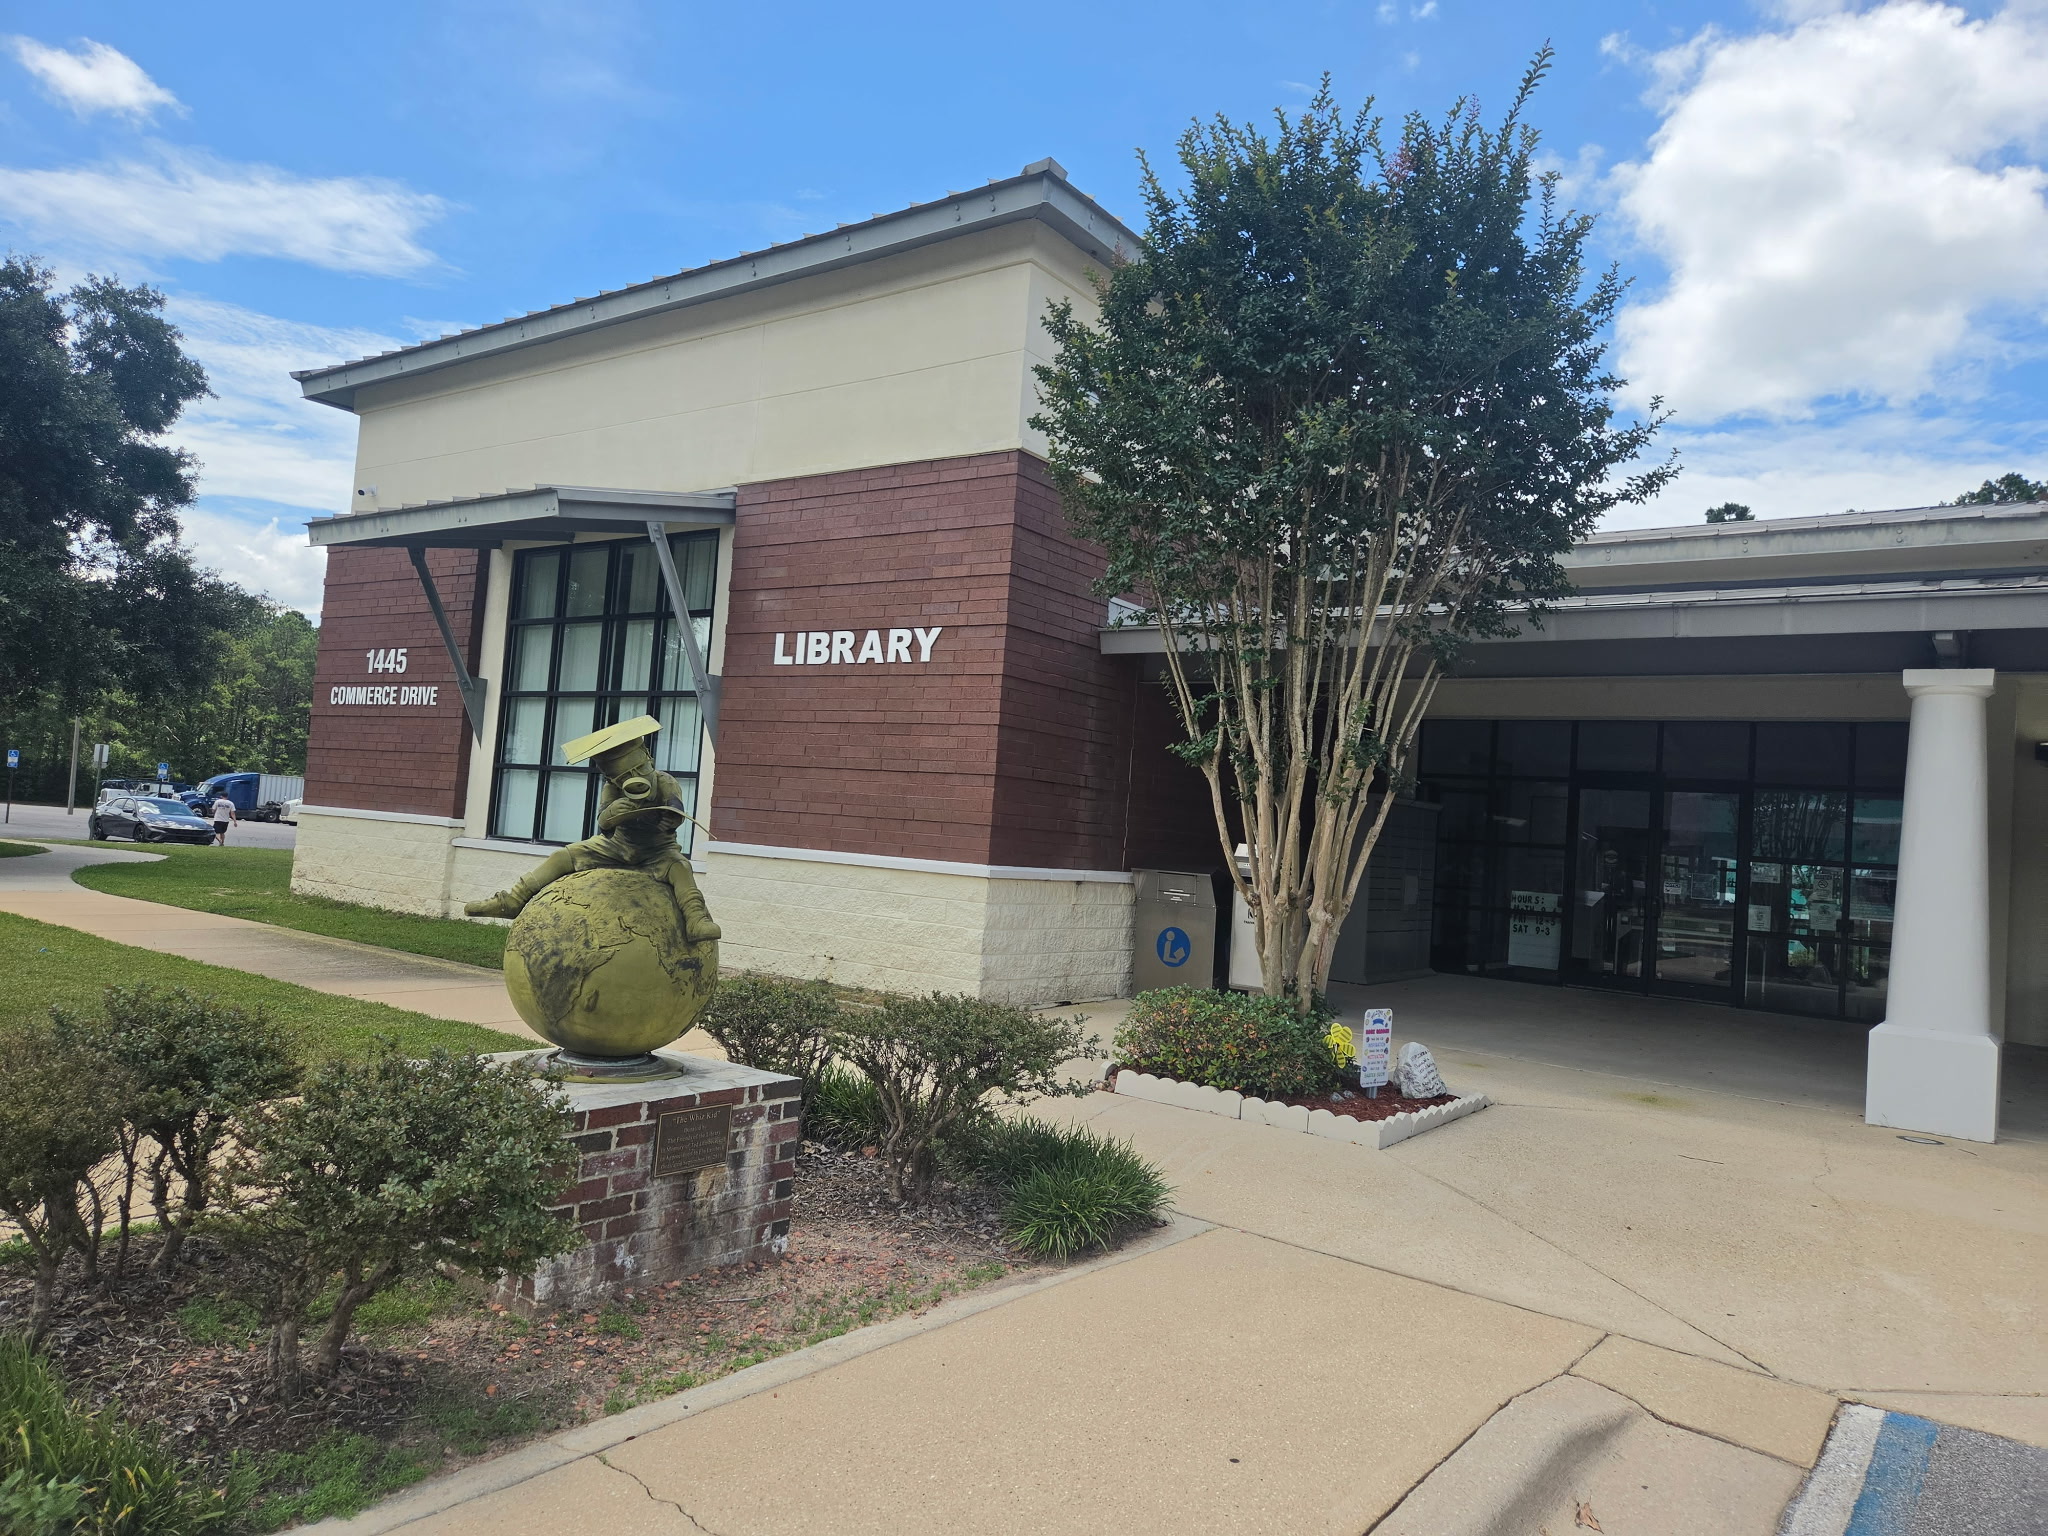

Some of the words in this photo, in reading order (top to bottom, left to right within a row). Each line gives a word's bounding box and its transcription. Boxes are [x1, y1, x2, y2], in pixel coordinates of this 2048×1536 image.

[774, 627, 943, 665] LIBRARY
[366, 648, 408, 674] 1445
[330, 686, 398, 705] COMMERCE
[400, 686, 438, 706] DRIVE
[1511, 894, 1545, 904] HOURS:
[1512, 923, 1529, 934] SAT
[1535, 926, 1550, 936] 9-3
[689, 1113, 705, 1121] Whiz
